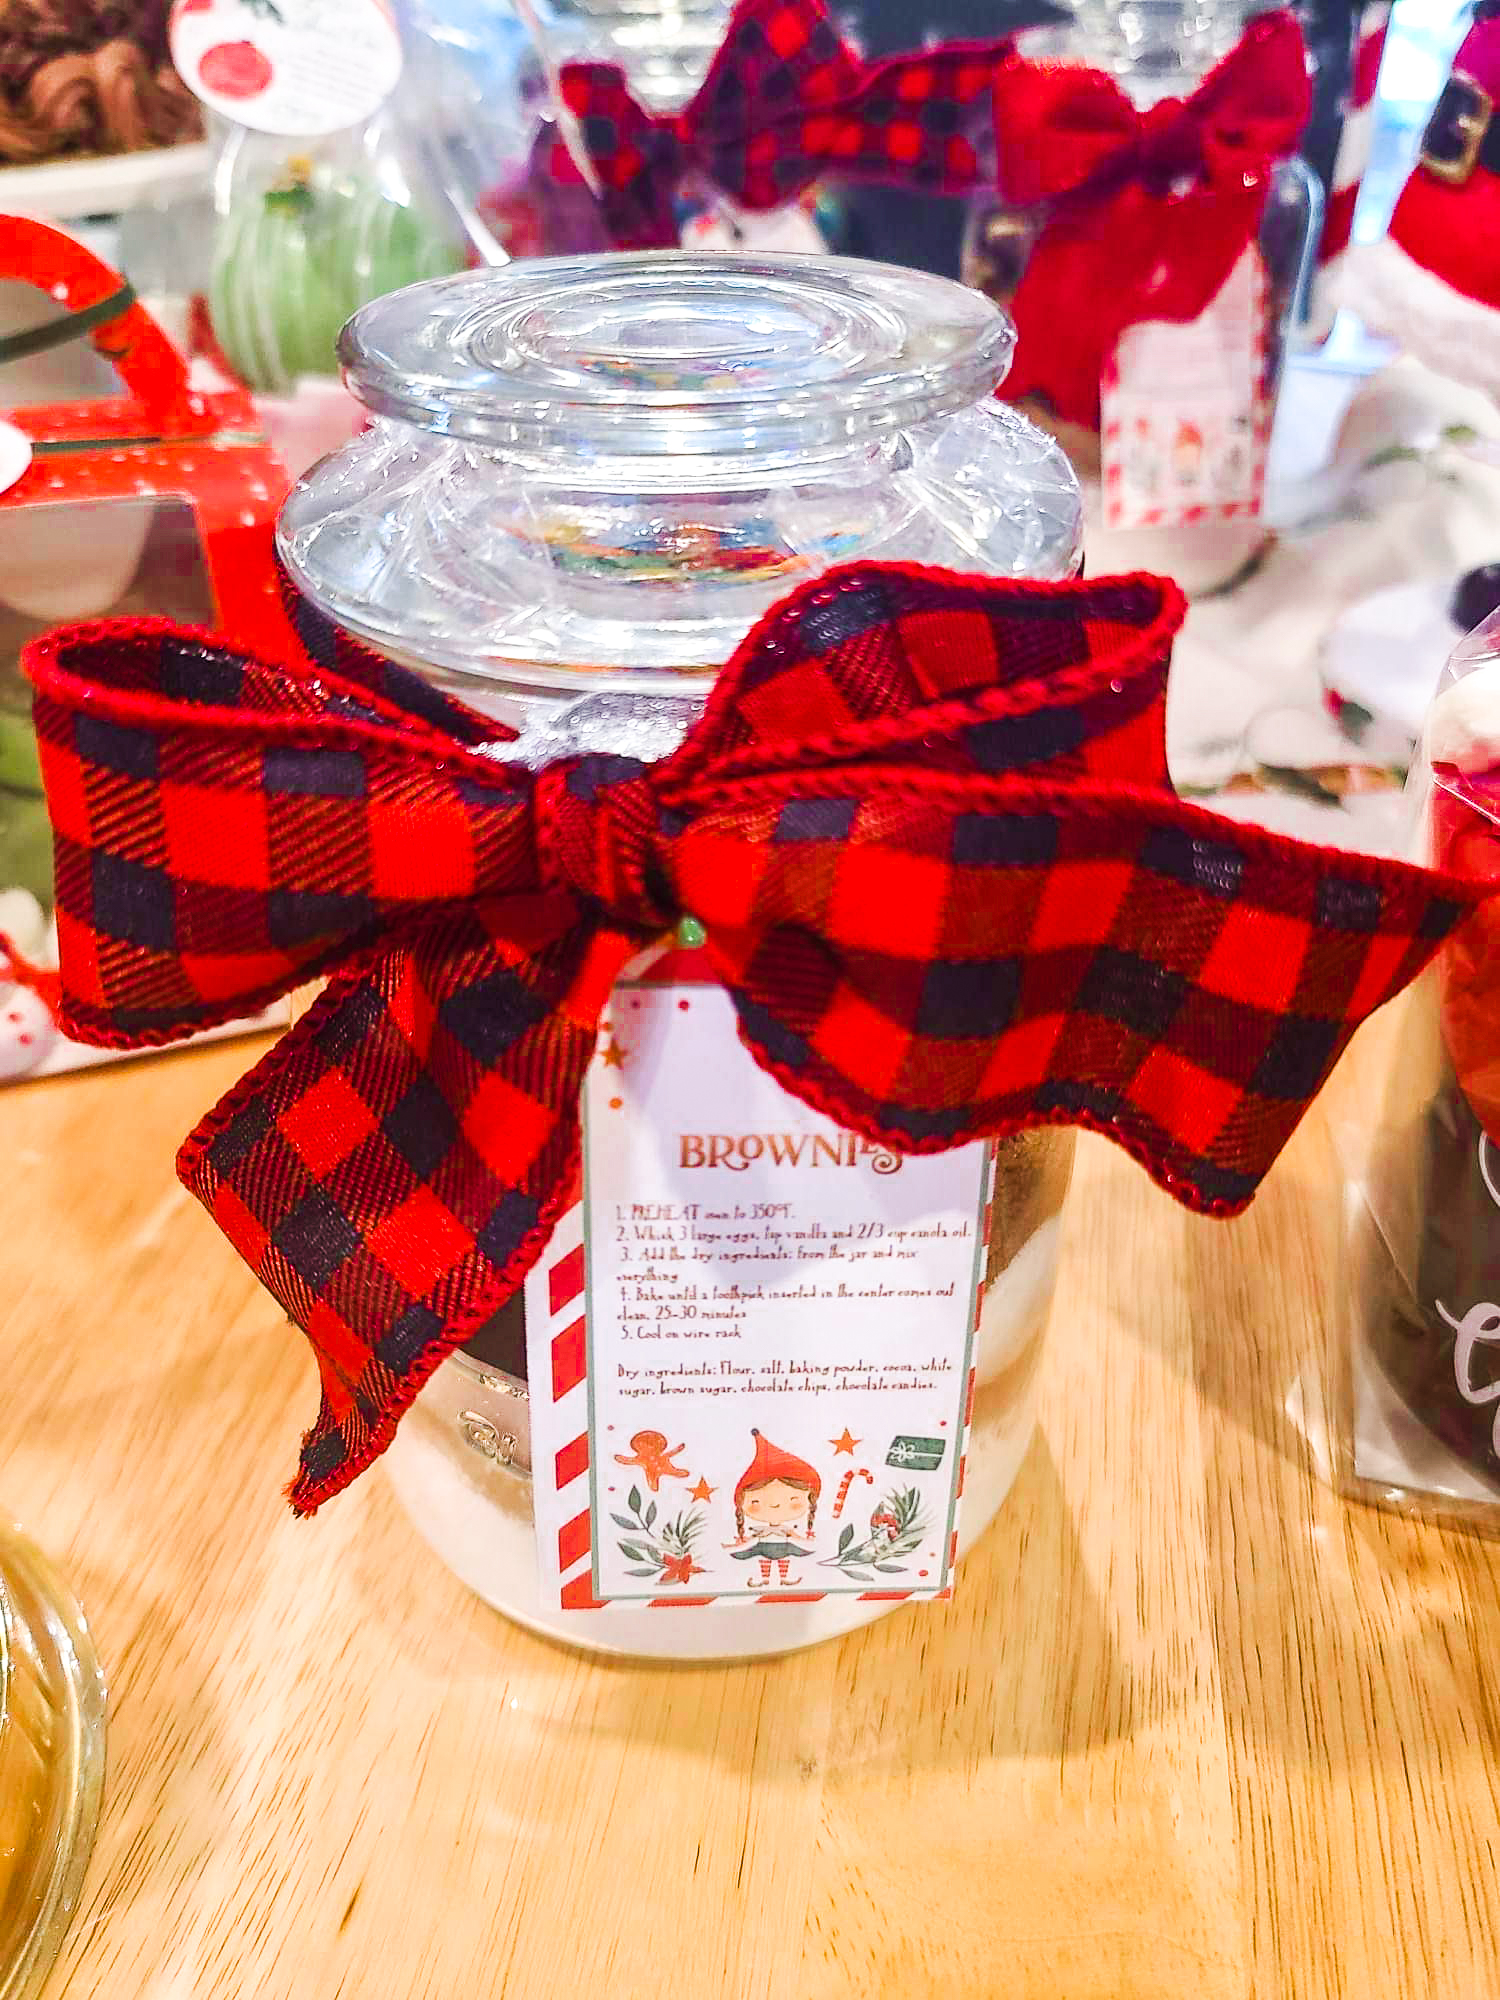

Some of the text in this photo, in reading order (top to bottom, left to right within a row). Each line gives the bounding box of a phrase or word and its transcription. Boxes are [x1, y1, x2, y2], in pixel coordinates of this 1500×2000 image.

[616, 1204, 627, 1220] 1.
[631, 1203, 701, 1220] PREHEAT
[734, 1204, 747, 1220] to
[616, 1225, 630, 1242] 2.
[634, 1225, 675, 1241] Whisk
[679, 1225, 688, 1241] 3
[691, 1224, 722, 1244] large
[786, 1222, 827, 1239] vanilla
[832, 1223, 852, 1238] and
[857, 1222, 884, 1239] 2/3
[887, 1231, 907, 1244] cup
[910, 1221, 948, 1238] canola
[620, 1246, 633, 1261] 3.
[640, 1246, 665, 1261] Add
[670, 1246, 686, 1261] the
[691, 1246, 713, 1264] dry
[797, 1244, 825, 1260] from
[828, 1243, 845, 1260] the
[848, 1248, 868, 1263] jar
[873, 1244, 893, 1259] and
[896, 1249, 919, 1259] mix
[616, 1265, 679, 1285] everything
[620, 1281, 955, 1305] 4. Bake until a toothpick inserted in the center comes out
[655, 1304, 697, 1321] 25-30
[701, 1304, 747, 1320] minutes
[620, 1323, 742, 1340] 5. Cool on wire rack
[618, 1363, 640, 1380] Dry
[644, 1361, 717, 1380] ingredients:
[788, 1359, 830, 1376] baking
[921, 1356, 952, 1372] white
[660, 1380, 695, 1396] brown
[741, 1376, 793, 1393] chocolate
[835, 1375, 889, 1392] chocolate
